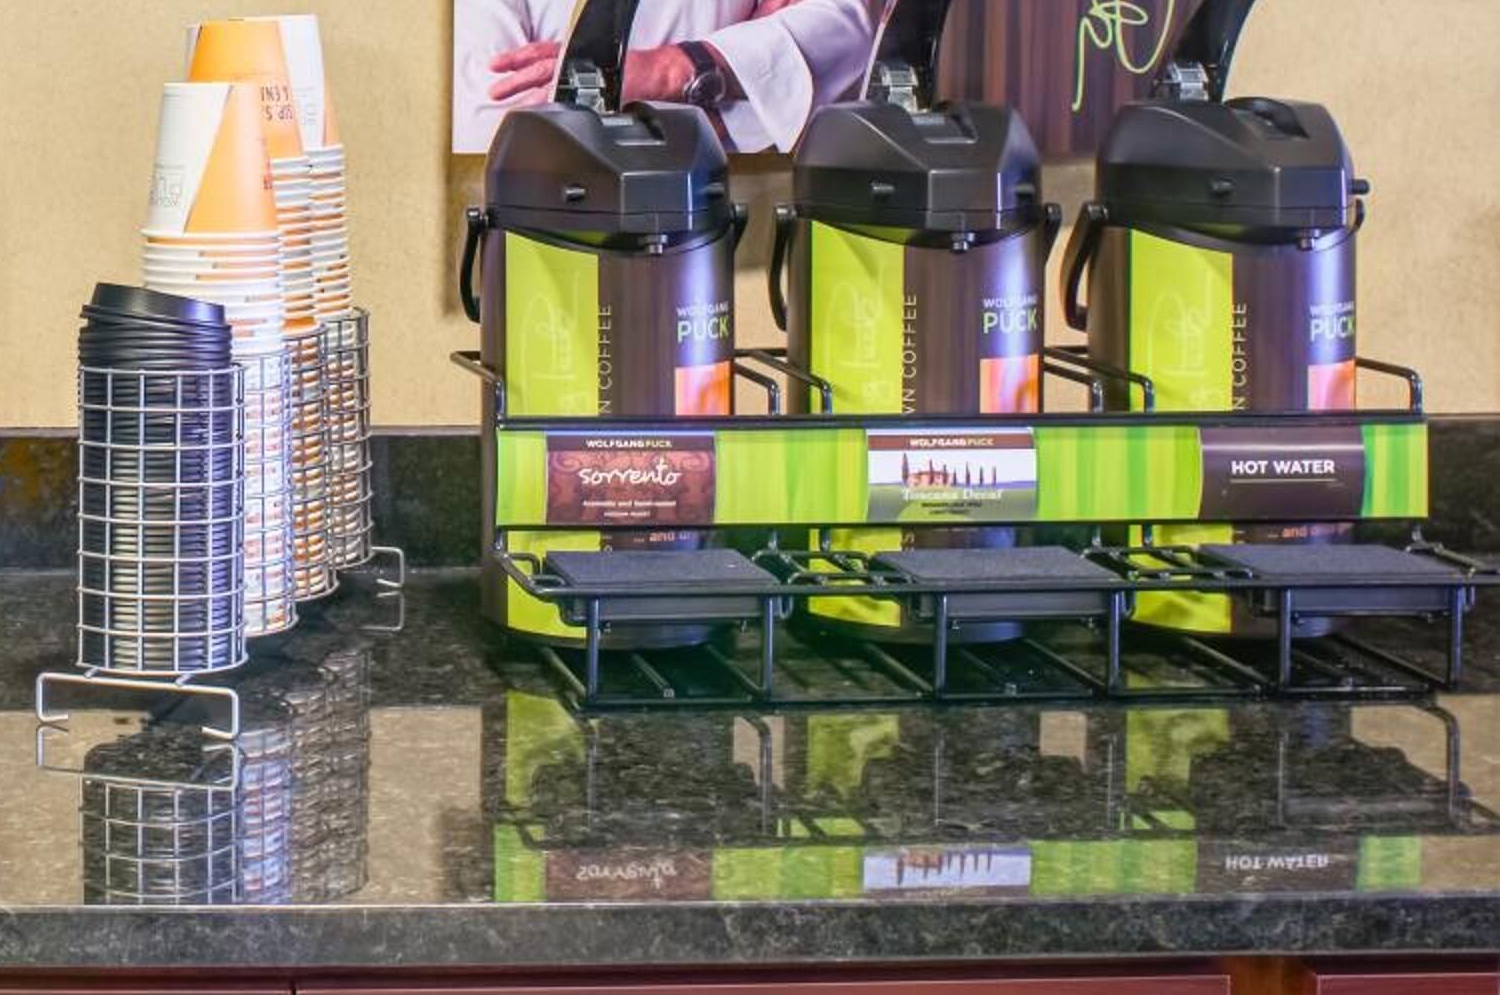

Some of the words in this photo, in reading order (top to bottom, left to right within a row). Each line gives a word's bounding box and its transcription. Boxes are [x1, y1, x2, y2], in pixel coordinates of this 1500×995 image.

[598, 305, 612, 389] COFFEE
[677, 317, 730, 343] PUCK
[902, 294, 918, 379] COFFEE
[983, 308, 1037, 334] PUCK
[1233, 302, 1248, 387] COFFEE
[1231, 460, 1268, 475] HOT
[1274, 460, 1335, 474] WATER
